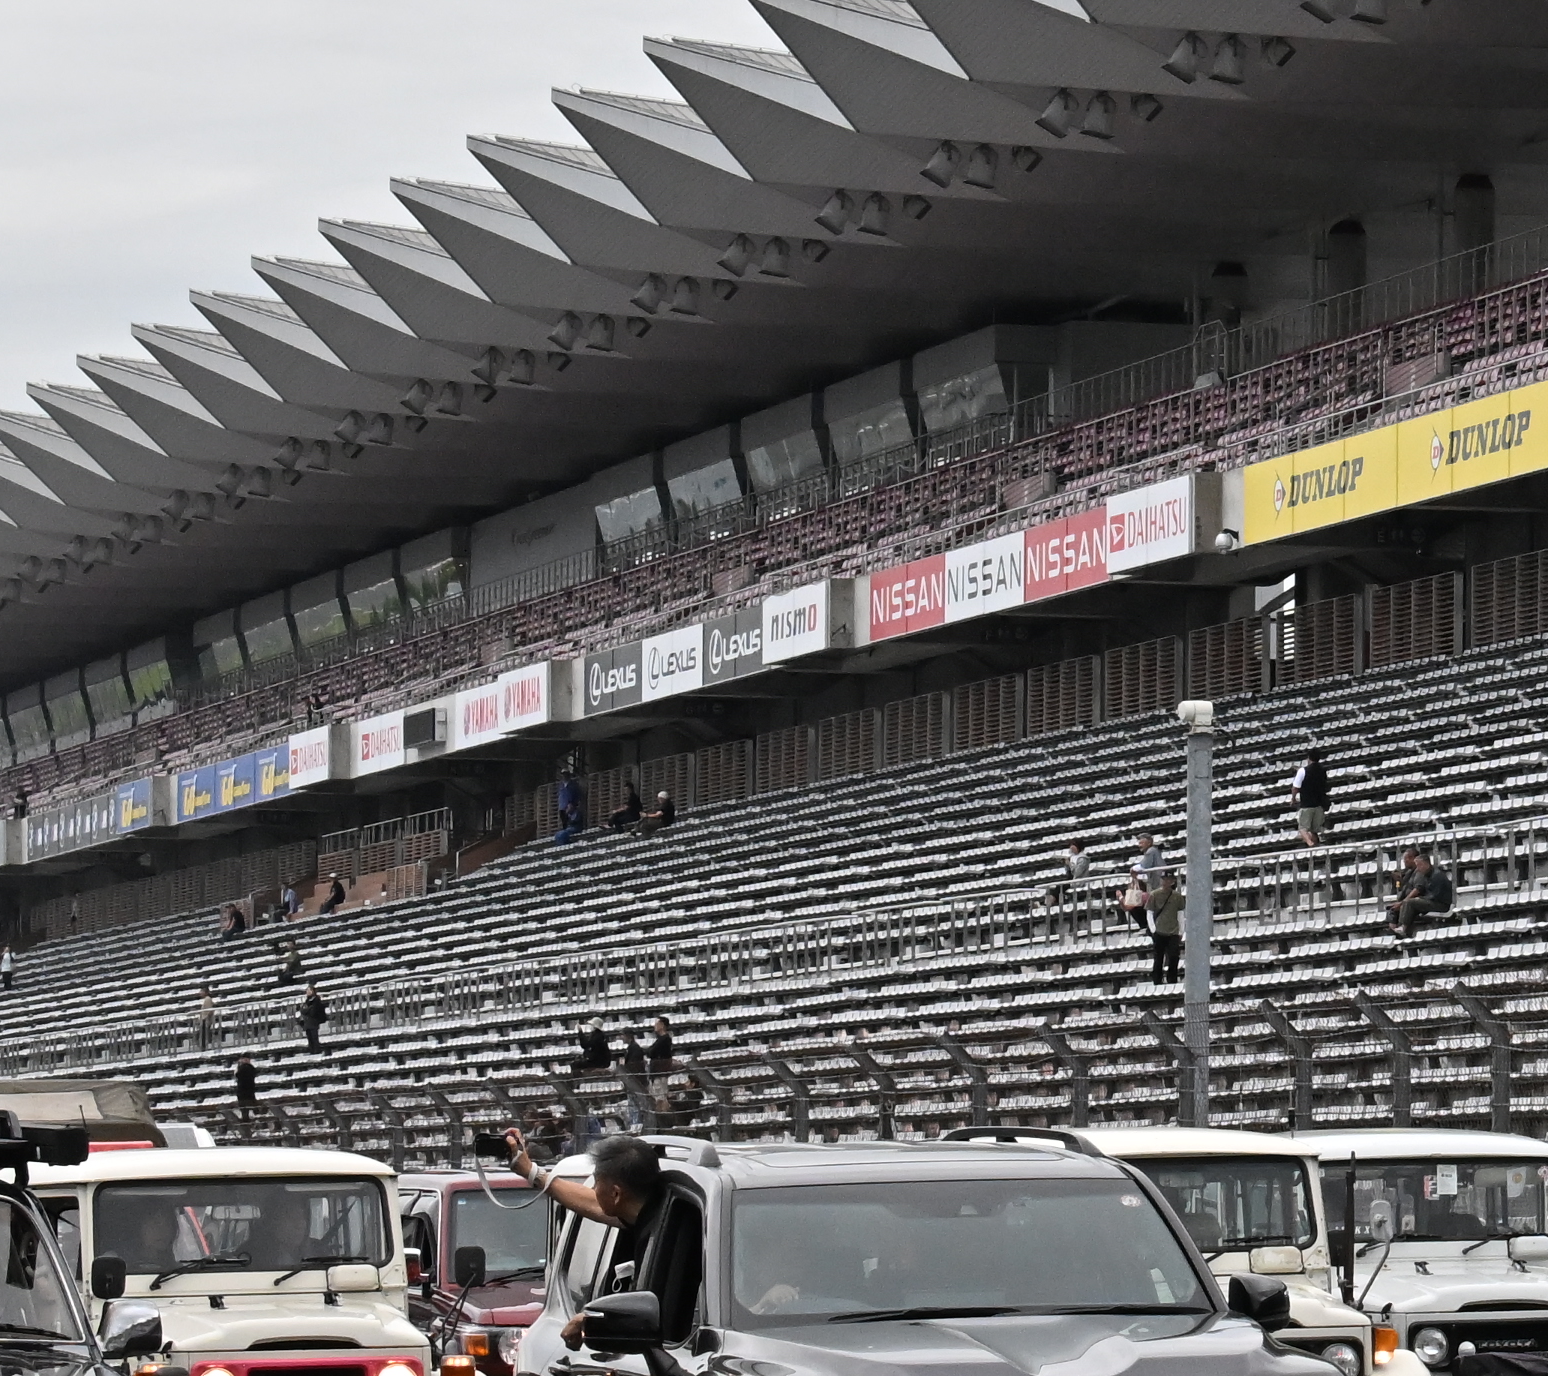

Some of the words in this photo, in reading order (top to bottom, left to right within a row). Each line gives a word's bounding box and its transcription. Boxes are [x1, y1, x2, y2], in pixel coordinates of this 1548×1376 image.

[1446, 410, 1531, 465] DUNLOP
[1287, 457, 1363, 508] DUNLOP
[1128, 497, 1187, 549] DAIHATSU
[1027, 525, 1106, 585] NISSAN
[873, 572, 943, 625] NISSAN
[947, 551, 1022, 605] NISSAN
[662, 647, 697, 679] LEXUS
[723, 628, 761, 661] LEXUS
[510, 676, 541, 718] YAMAHA
[602, 664, 636, 694] LEXUS
[470, 694, 499, 735] YAMAHA
[298, 740, 327, 773] DAIHATSU
[370, 726, 401, 758] DAIHATSU
